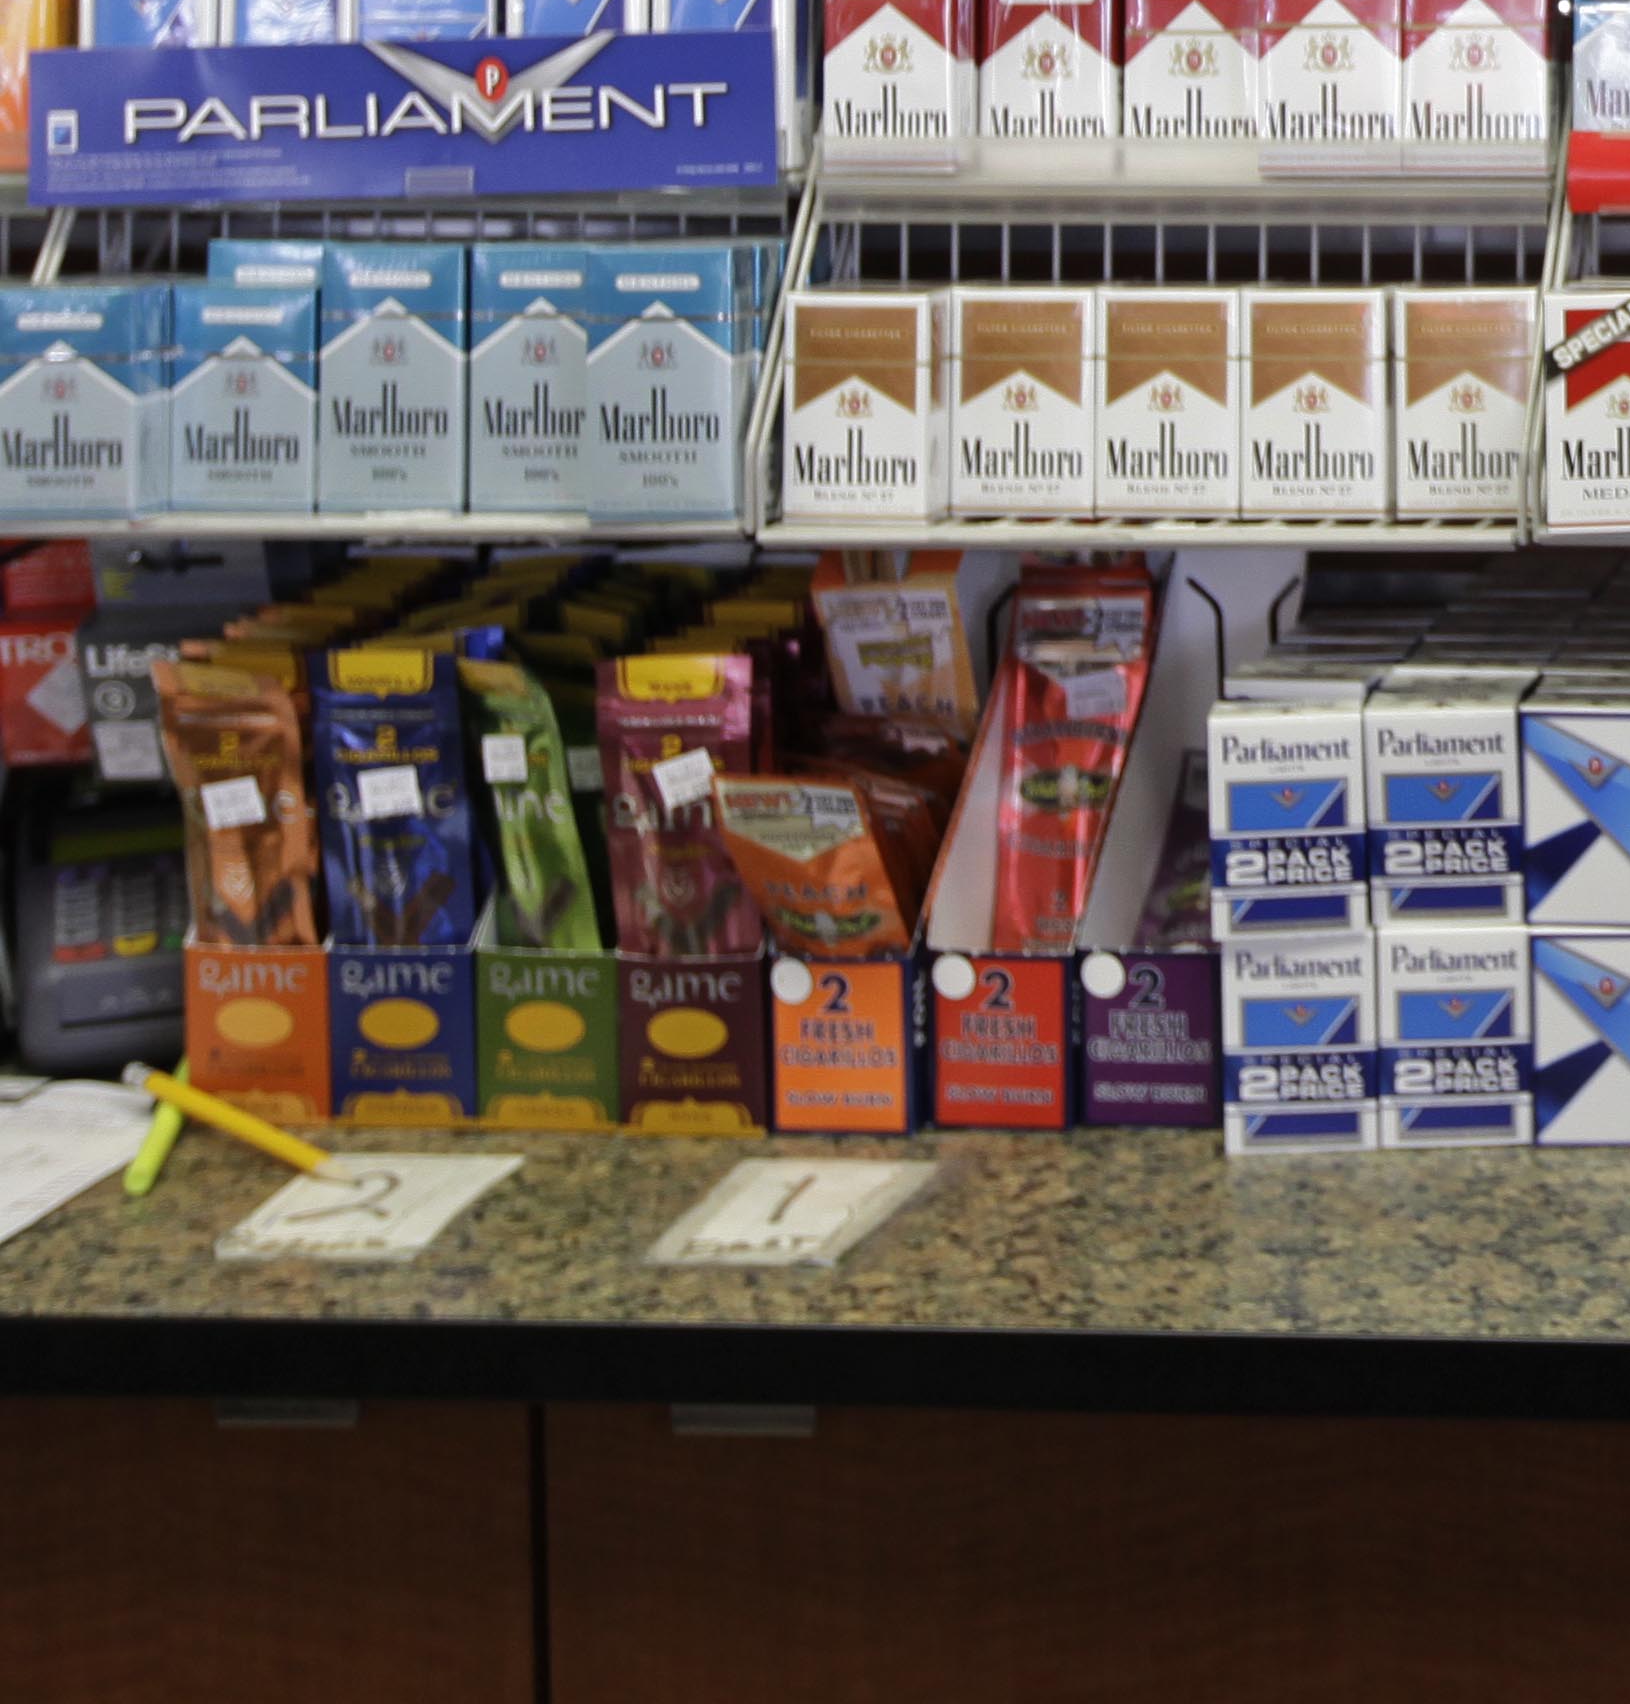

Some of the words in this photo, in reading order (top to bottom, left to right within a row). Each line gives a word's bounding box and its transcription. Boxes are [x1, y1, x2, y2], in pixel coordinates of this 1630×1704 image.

[125, 82, 727, 145] PARLIAMENT
[600, 387, 720, 443] Marlboro
[1252, 424, 1374, 482] Marlboro
[1222, 736, 1351, 766] Parliament
[1378, 730, 1505, 760] Parliament
[1228, 852, 1265, 886] 2
[1267, 848, 1348, 866] PACK
[1269, 866, 1353, 884] PRICE
[1386, 841, 1422, 876] 2
[1425, 839, 1504, 857] PACK
[1426, 857, 1507, 876] PRICE
[821, 973, 852, 1013] 2
[981, 969, 1014, 1010] 2
[801, 1019, 875, 1042] FRESH
[961, 1016, 1036, 1039] FRESH
